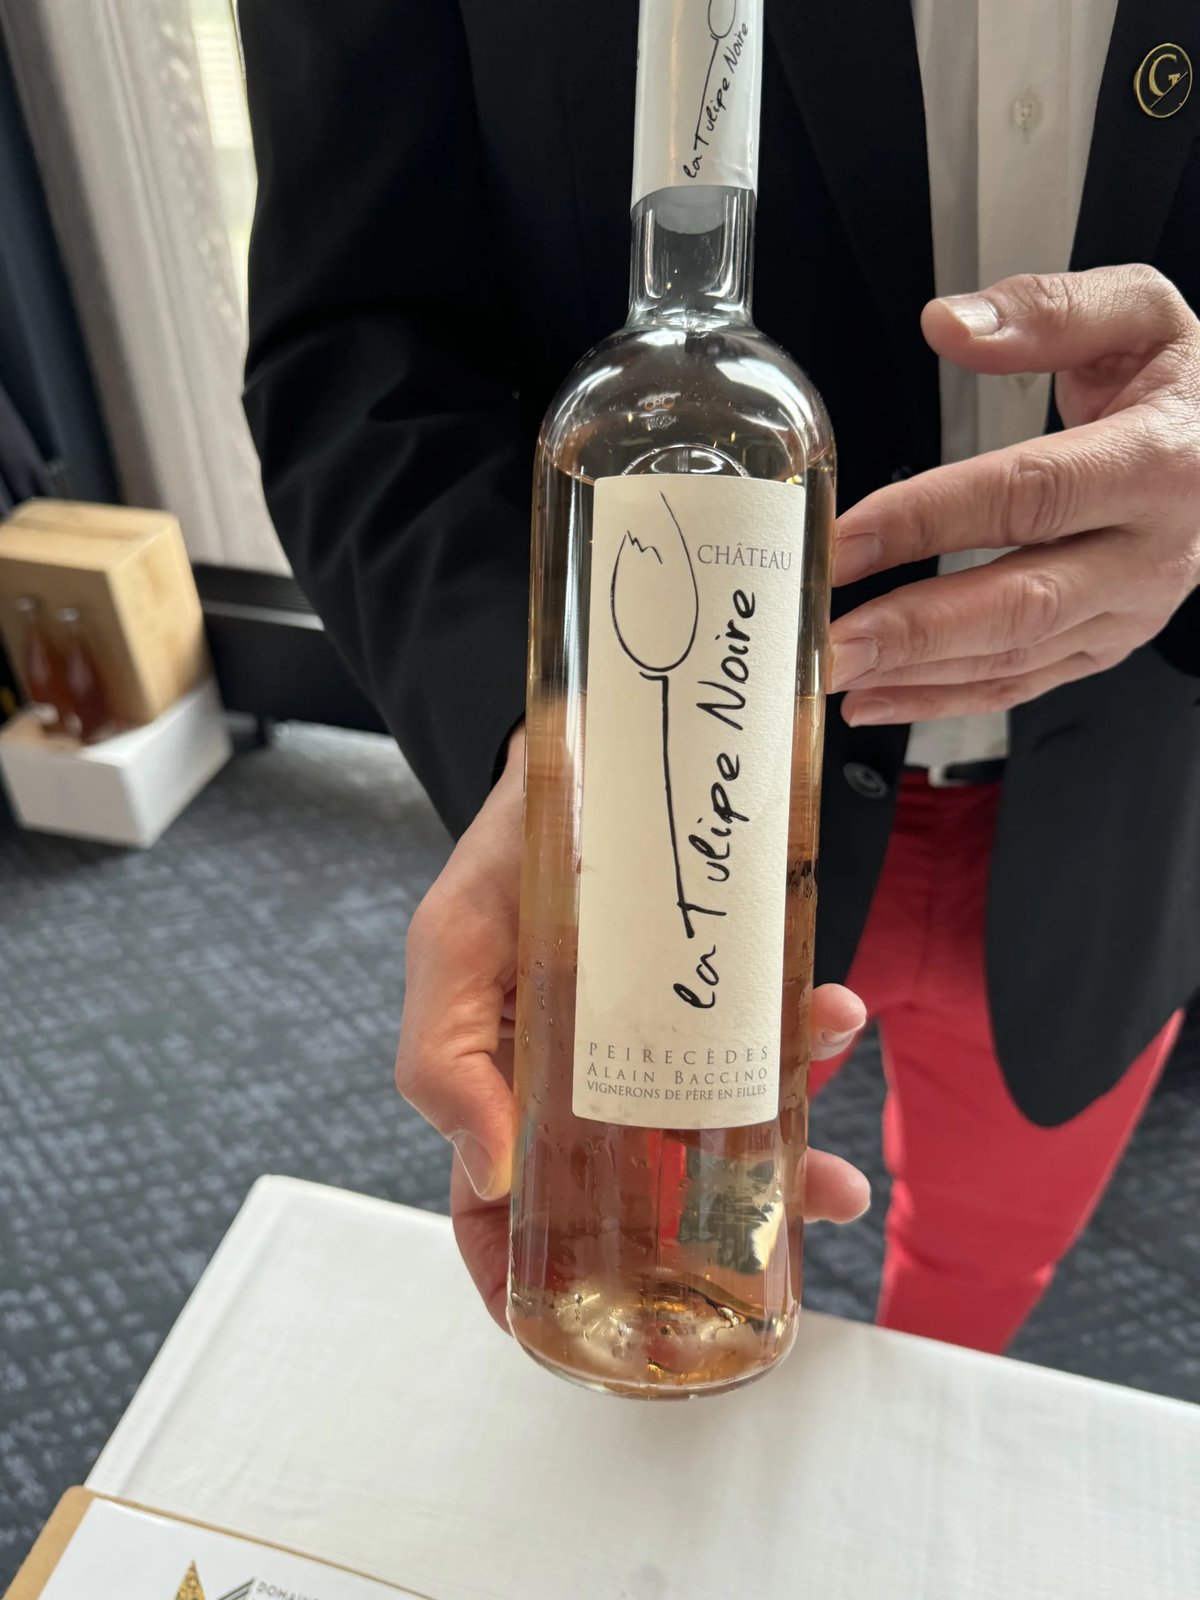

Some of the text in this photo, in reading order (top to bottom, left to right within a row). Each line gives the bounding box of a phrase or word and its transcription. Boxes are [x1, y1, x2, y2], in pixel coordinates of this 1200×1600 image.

[693, 77, 731, 151] Tulipe
[723, 22, 749, 74] Noire
[697, 542, 792, 571] CHÂTEAU
[695, 588, 756, 731] Noire
[676, 752, 750, 939] Tulipe
[588, 1041, 768, 1066] PEIRECÈDES
[586, 1061, 768, 1086] ALAIN BACCINO
[586, 1080, 768, 1101] VIGNERONS DE PÈRE EN FILLES
